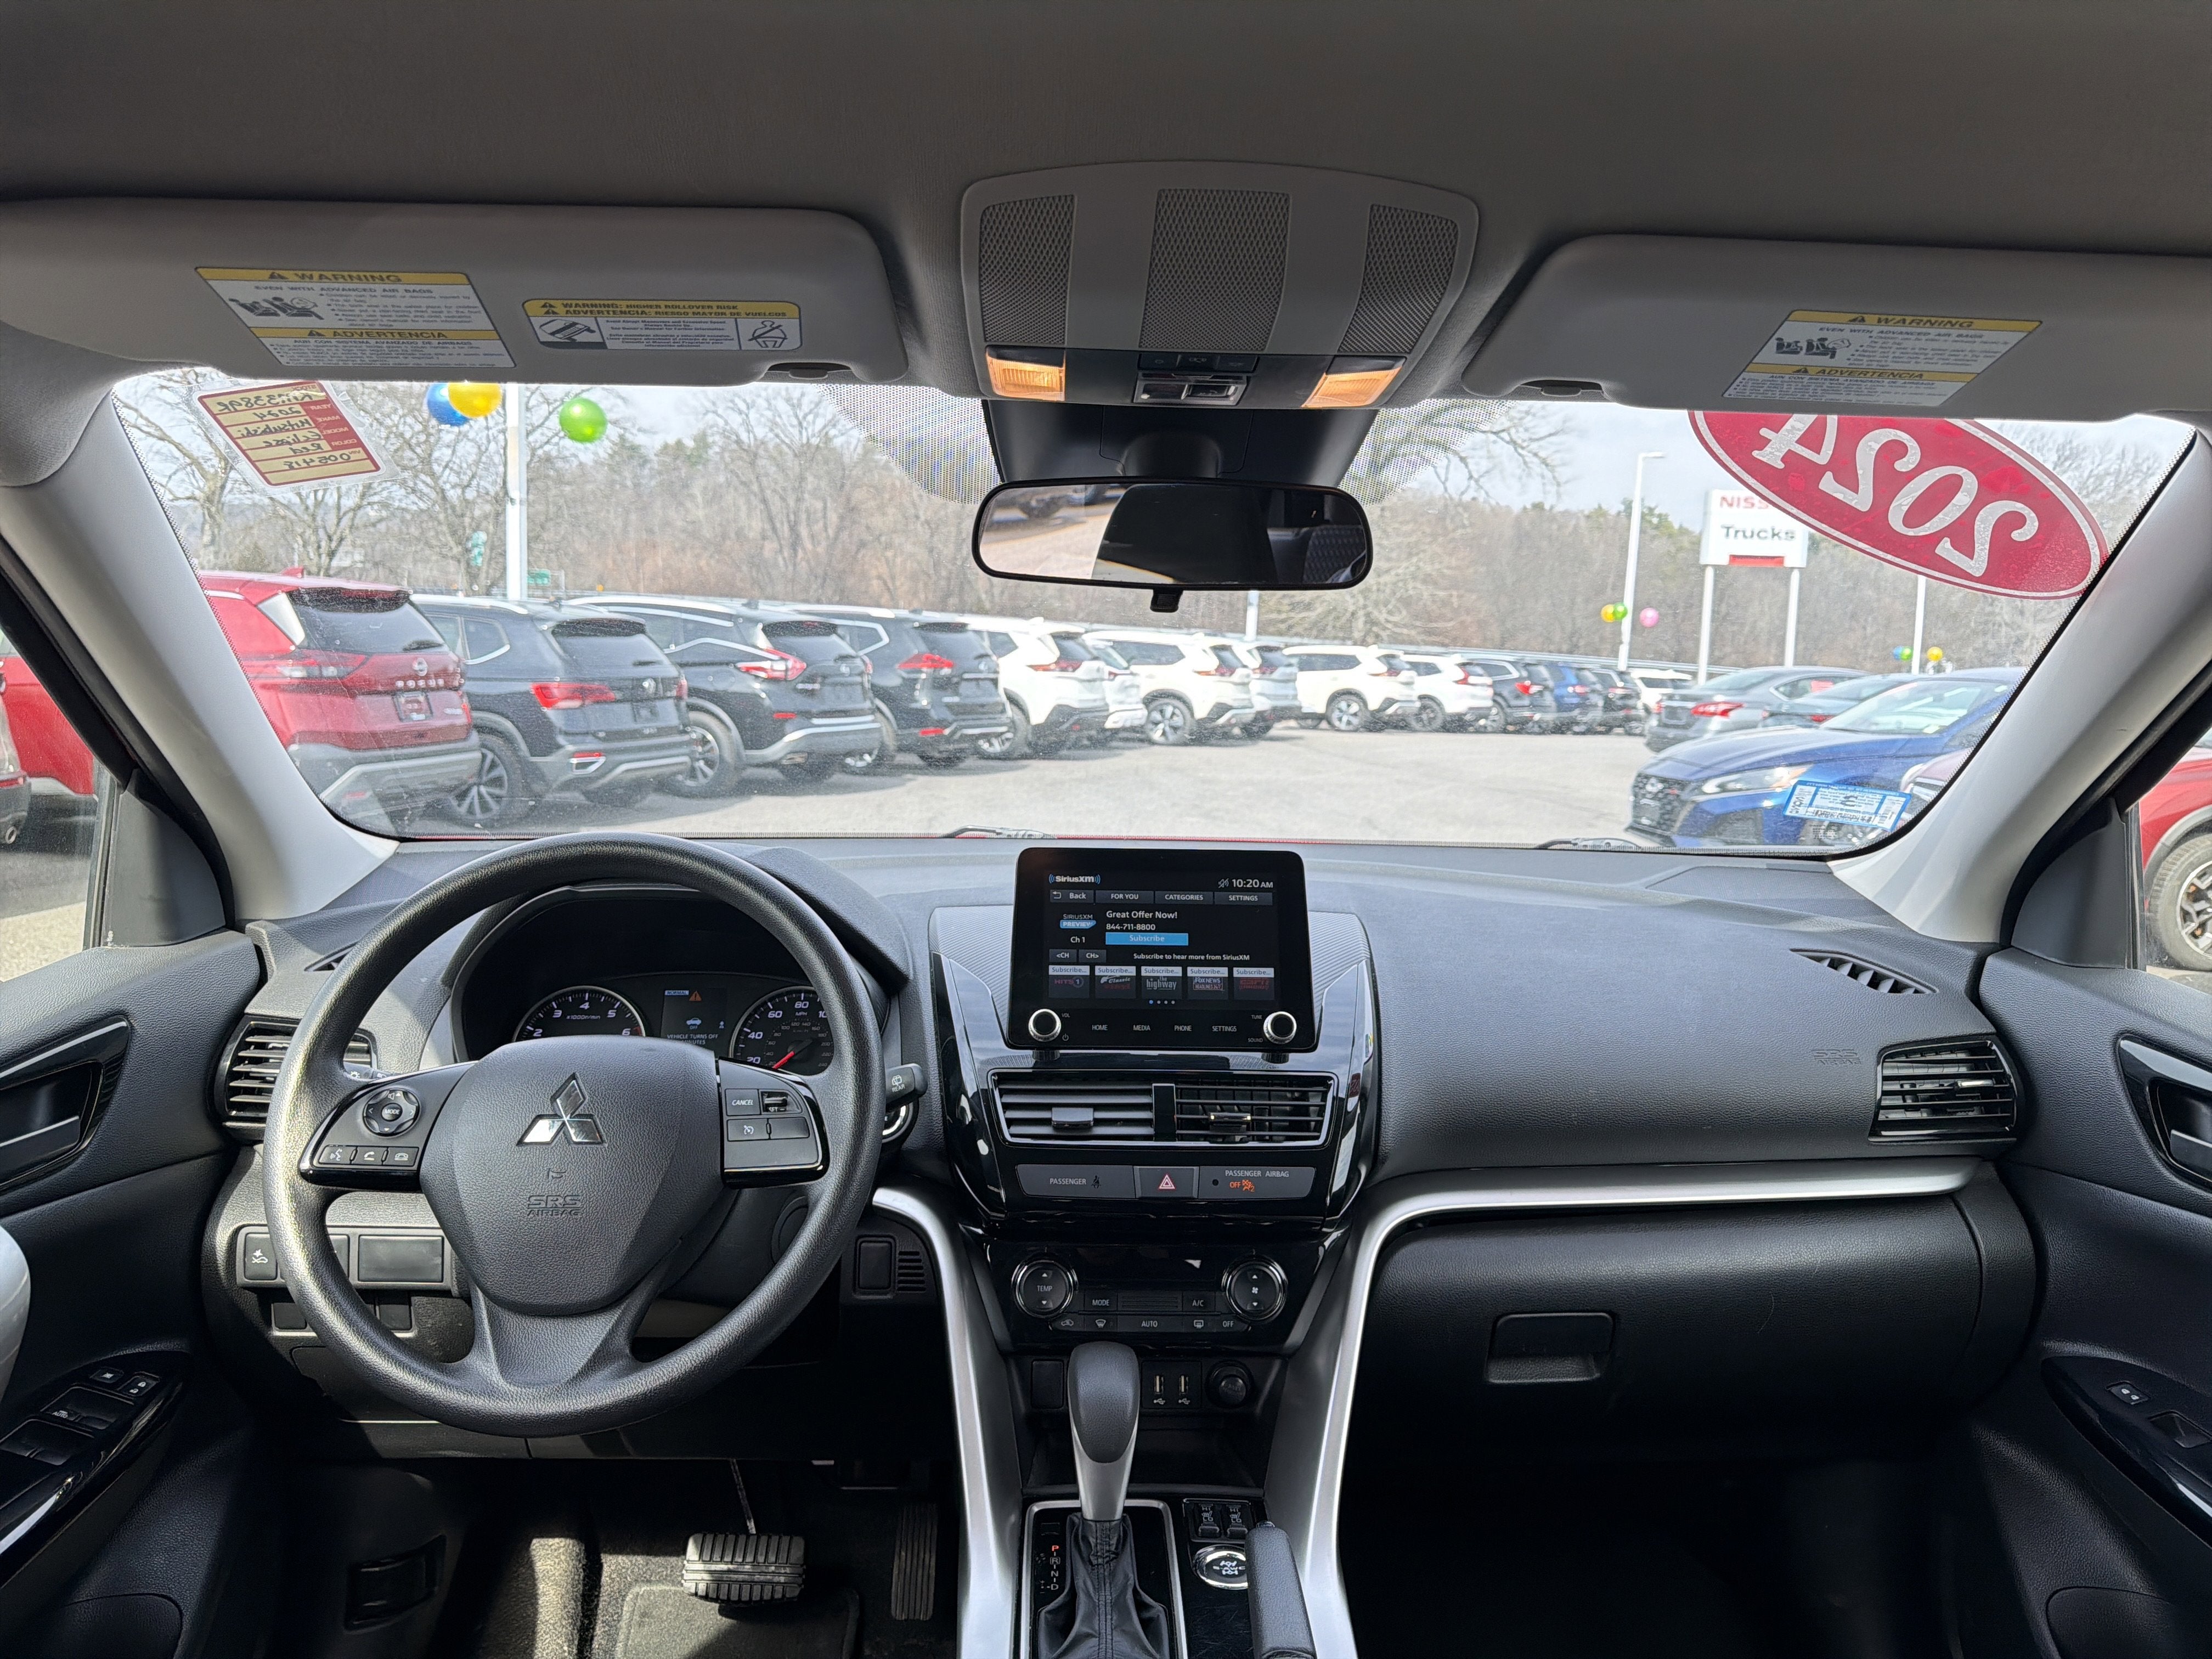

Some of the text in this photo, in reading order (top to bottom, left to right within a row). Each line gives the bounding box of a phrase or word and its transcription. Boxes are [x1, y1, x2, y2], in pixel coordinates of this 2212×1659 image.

[294, 273, 403, 283] WARNING
[1876, 317, 1974, 328] WARNING
[1815, 369, 1923, 379] ADVERTENCIA
[1719, 495, 1769, 509] NISS
[1721, 524, 1796, 540] Trucks
[1232, 879, 1260, 888] 10:20
[1146, 979, 1177, 990] highway
[579, 1002, 590, 1010] 4
[552, 1009, 562, 1018] 3
[607, 1009, 617, 1018] 5
[533, 1029, 543, 1037] 2
[891, 1085, 906, 1093] REAR
[527, 1195, 583, 1208] SRS
